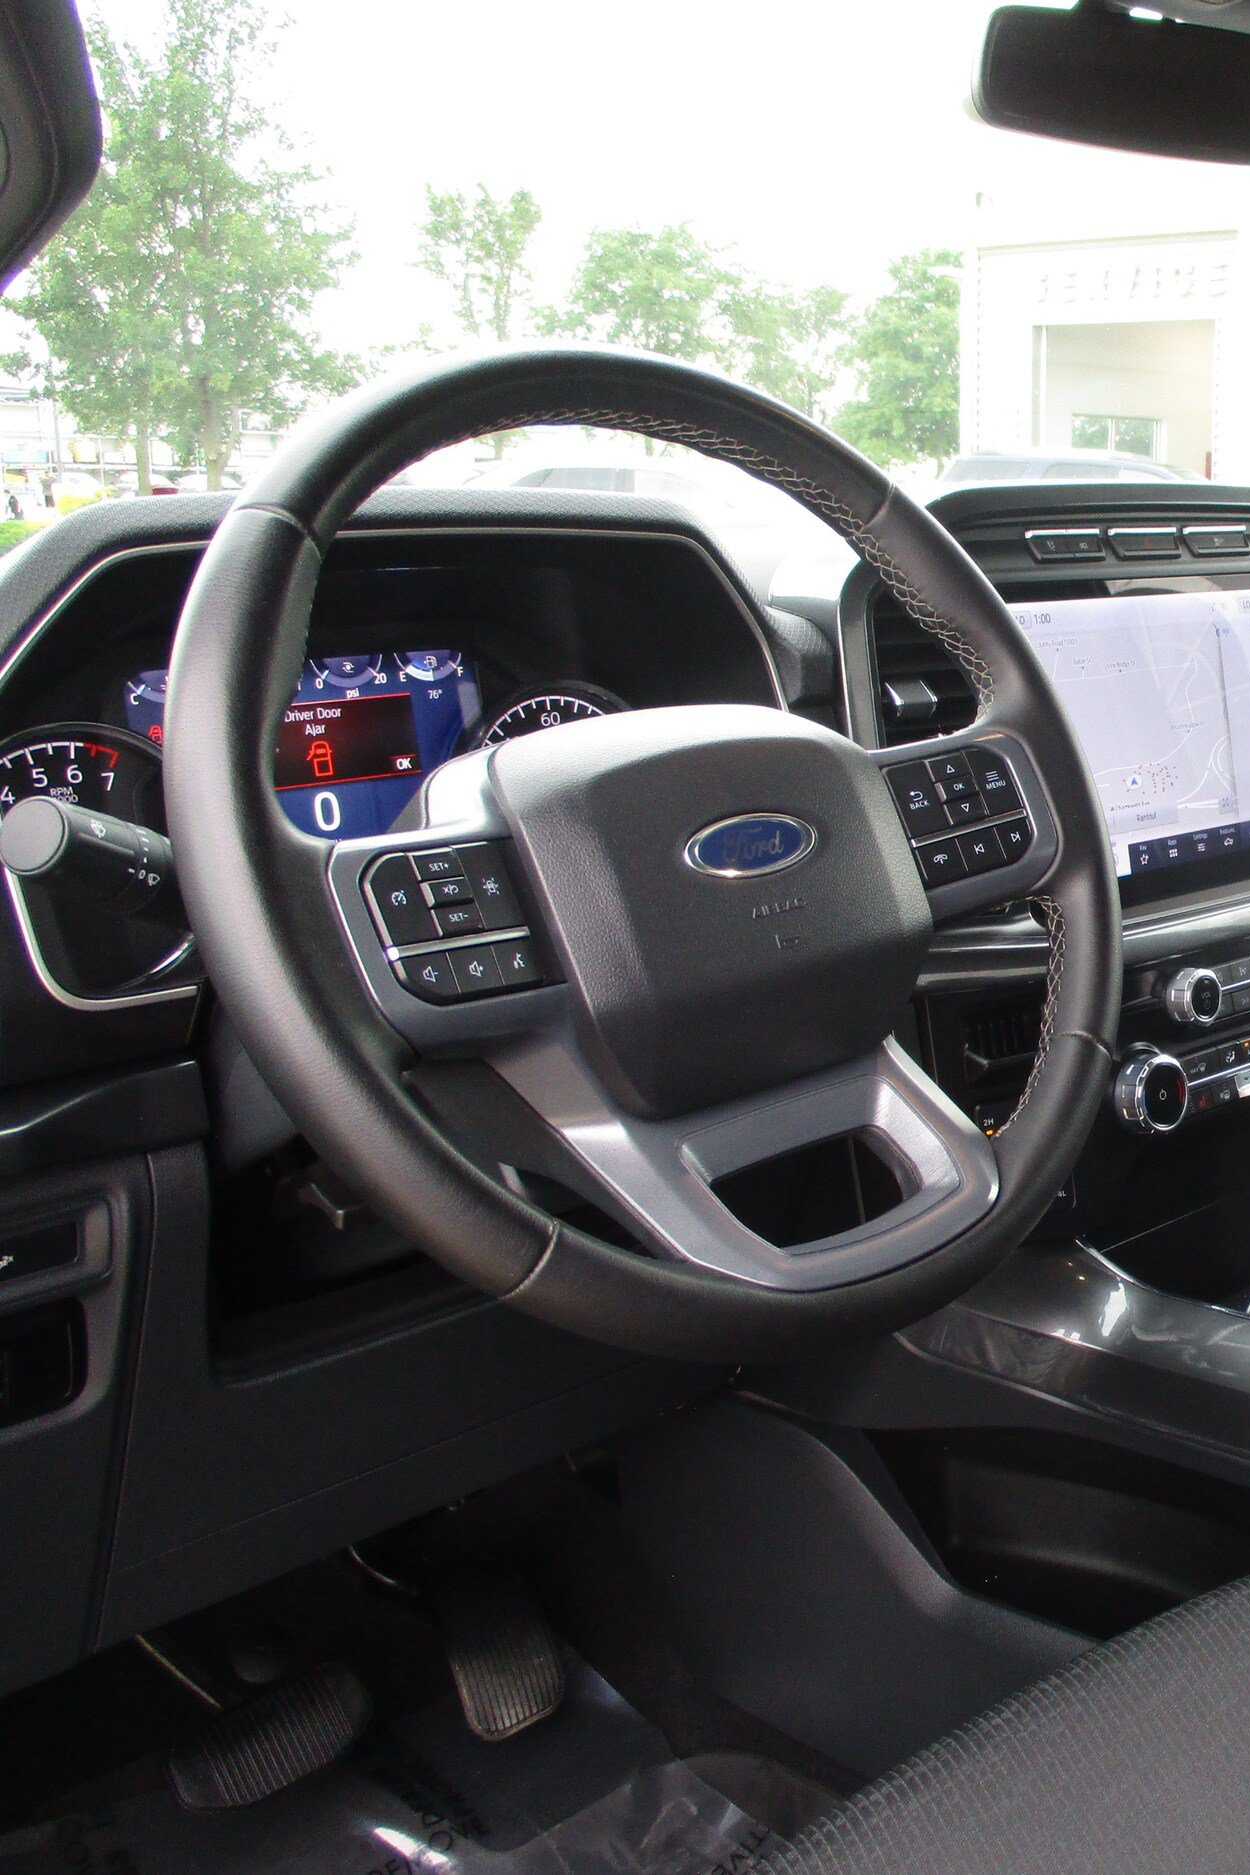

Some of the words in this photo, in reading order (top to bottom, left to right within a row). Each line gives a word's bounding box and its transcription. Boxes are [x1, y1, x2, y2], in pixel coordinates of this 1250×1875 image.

[1033, 613, 1051, 624] 1:00
[400, 672, 407, 682] E
[457, 667, 464, 677] F
[315, 678, 324, 689] 0
[374, 673, 387, 684] 20
[346, 688, 360, 699] psi
[427, 689, 443, 700] 76°
[284, 710, 315, 722] Driver
[316, 707, 342, 719] Door
[540, 711, 561, 727] 60
[305, 724, 326, 736] Ajar
[396, 758, 412, 770] OK
[32, 768, 48, 788] 5
[66, 765, 83, 784] 6
[101, 772, 115, 791] 7
[953, 782, 965, 791] OK
[985, 780, 1006, 790] MENU
[0, 785, 16, 804] 4
[49, 786, 74, 797] RPM
[909, 799, 929, 810] BACK
[314, 791, 341, 831] 0
[1136, 811, 1157, 822] Rantoul
[983, 1118, 994, 1127] 2H
